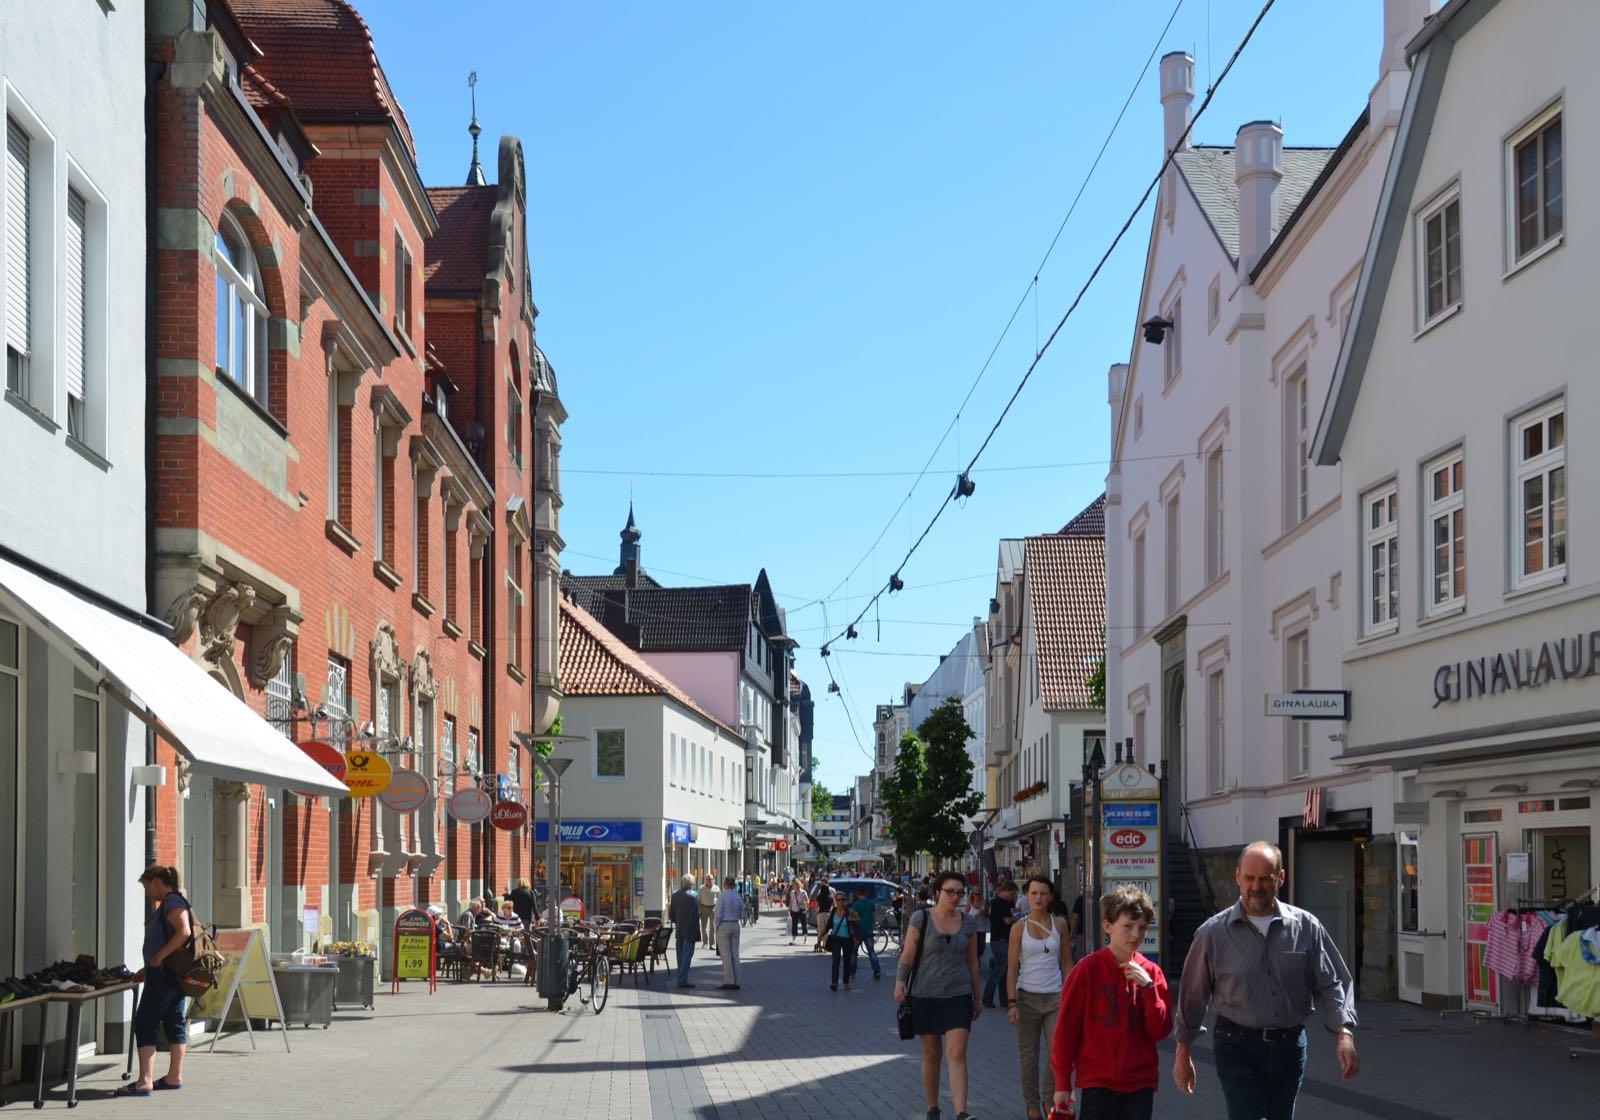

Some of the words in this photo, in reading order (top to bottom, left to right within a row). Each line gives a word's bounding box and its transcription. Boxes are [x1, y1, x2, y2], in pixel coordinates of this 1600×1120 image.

[1273, 699, 1338, 709] GINALAURA
[346, 779, 376, 787] DHL
[1116, 832, 1140, 844] edc
[404, 959, 423, 968] 1.99
